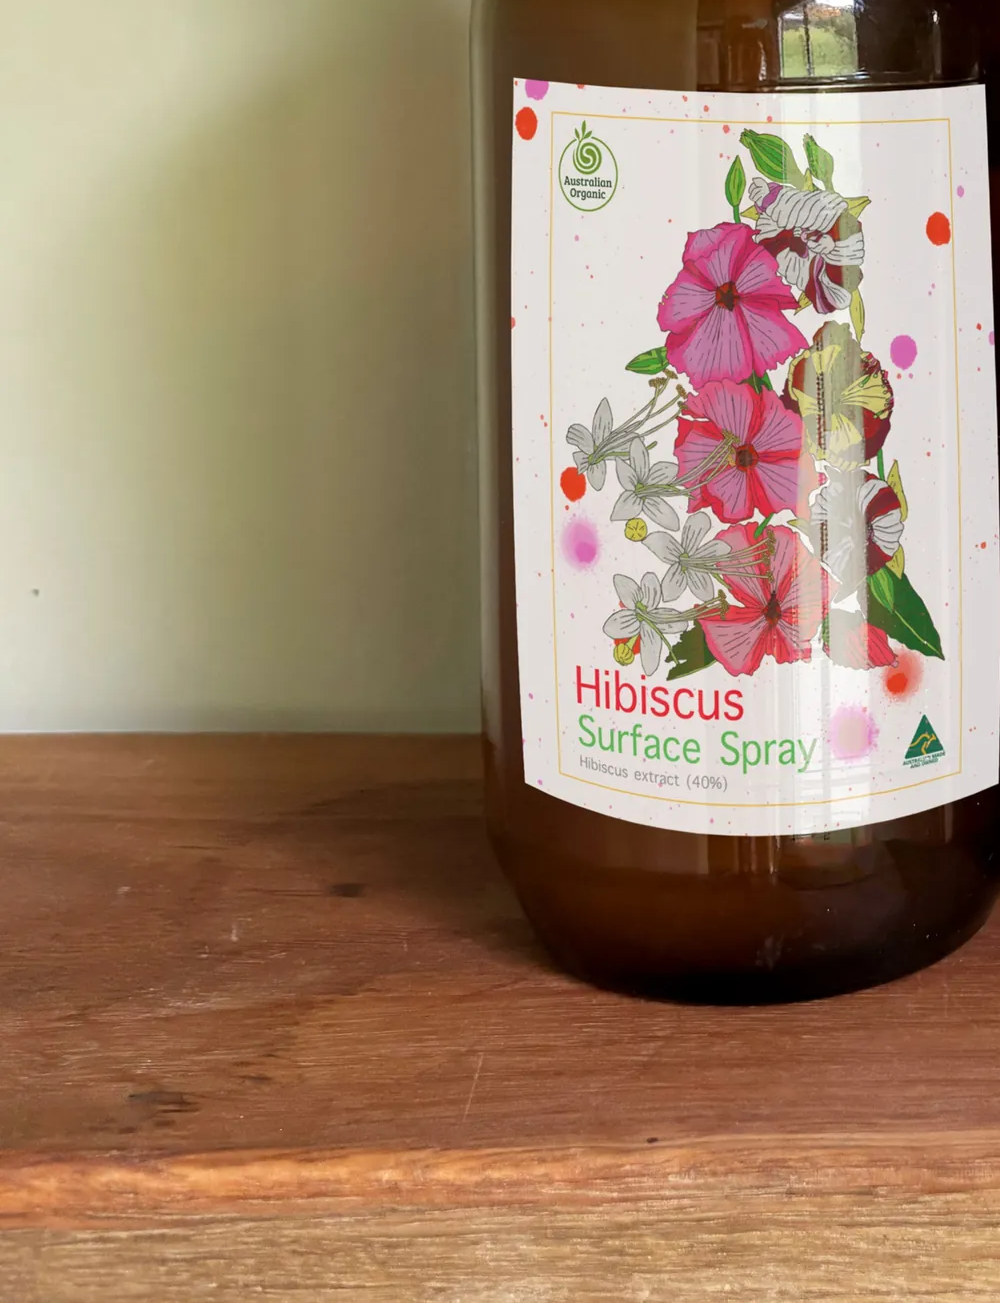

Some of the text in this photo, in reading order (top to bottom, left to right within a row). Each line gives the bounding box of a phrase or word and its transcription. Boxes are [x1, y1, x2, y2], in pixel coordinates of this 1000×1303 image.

[564, 176, 612, 188] Australian
[570, 188, 606, 201] Organic
[576, 665, 744, 721] Hibiscus
[578, 714, 818, 776] Surface Spray
[579, 754, 729, 793] Hibiscus extract (40%)
